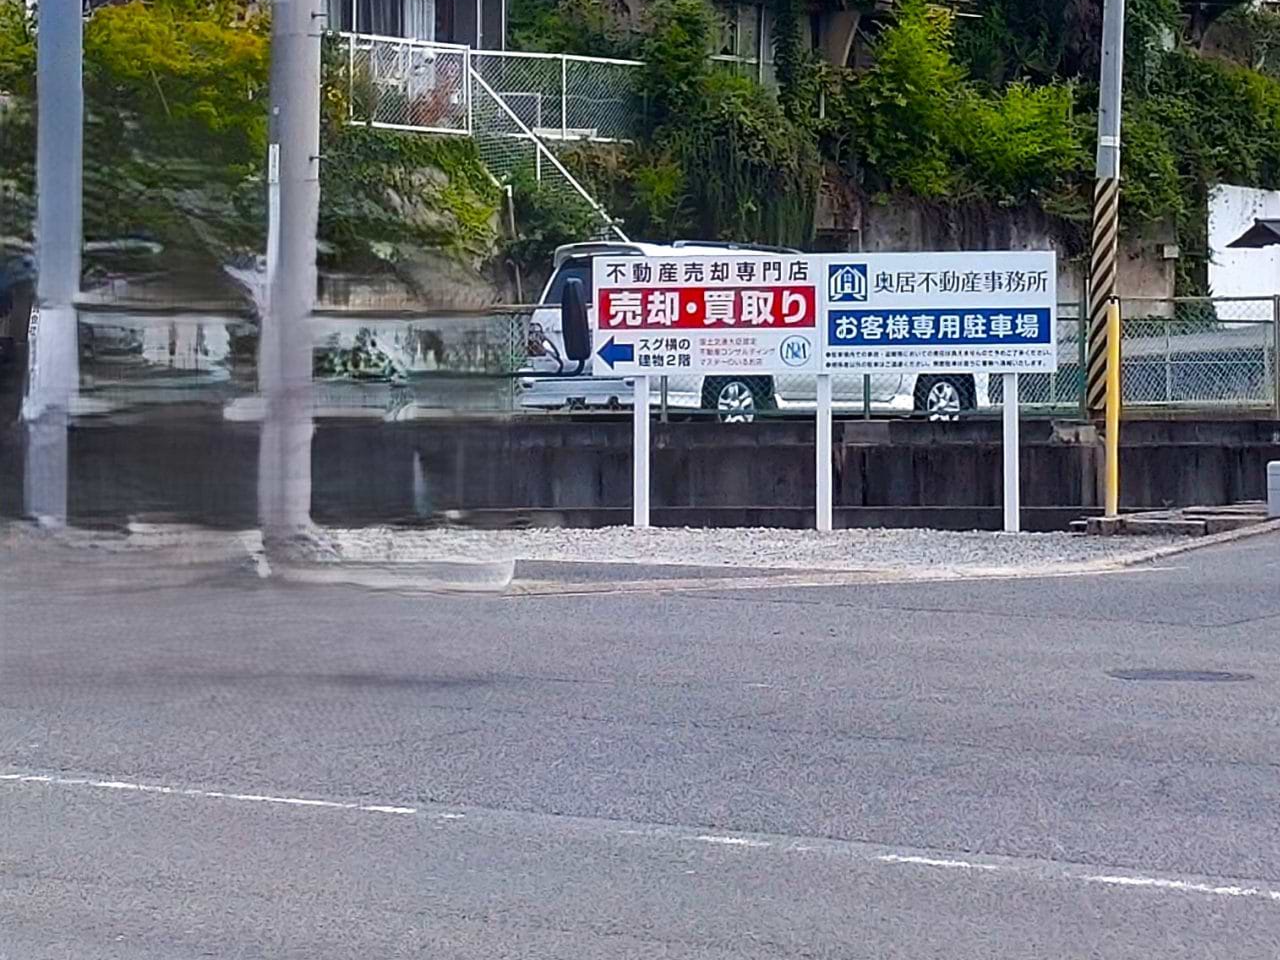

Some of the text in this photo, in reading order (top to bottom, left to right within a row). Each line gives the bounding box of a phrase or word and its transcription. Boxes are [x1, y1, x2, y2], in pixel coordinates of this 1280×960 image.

[606, 260, 809, 284] 不動産売却専門店
[873, 270, 1049, 293] 奥居不動産事務所
[608, 290, 808, 327] 売却・買取り
[835, 314, 1040, 340] お客様専用駐車場
[638, 337, 691, 352] スグ横の
[638, 353, 691, 367] 建物2階
